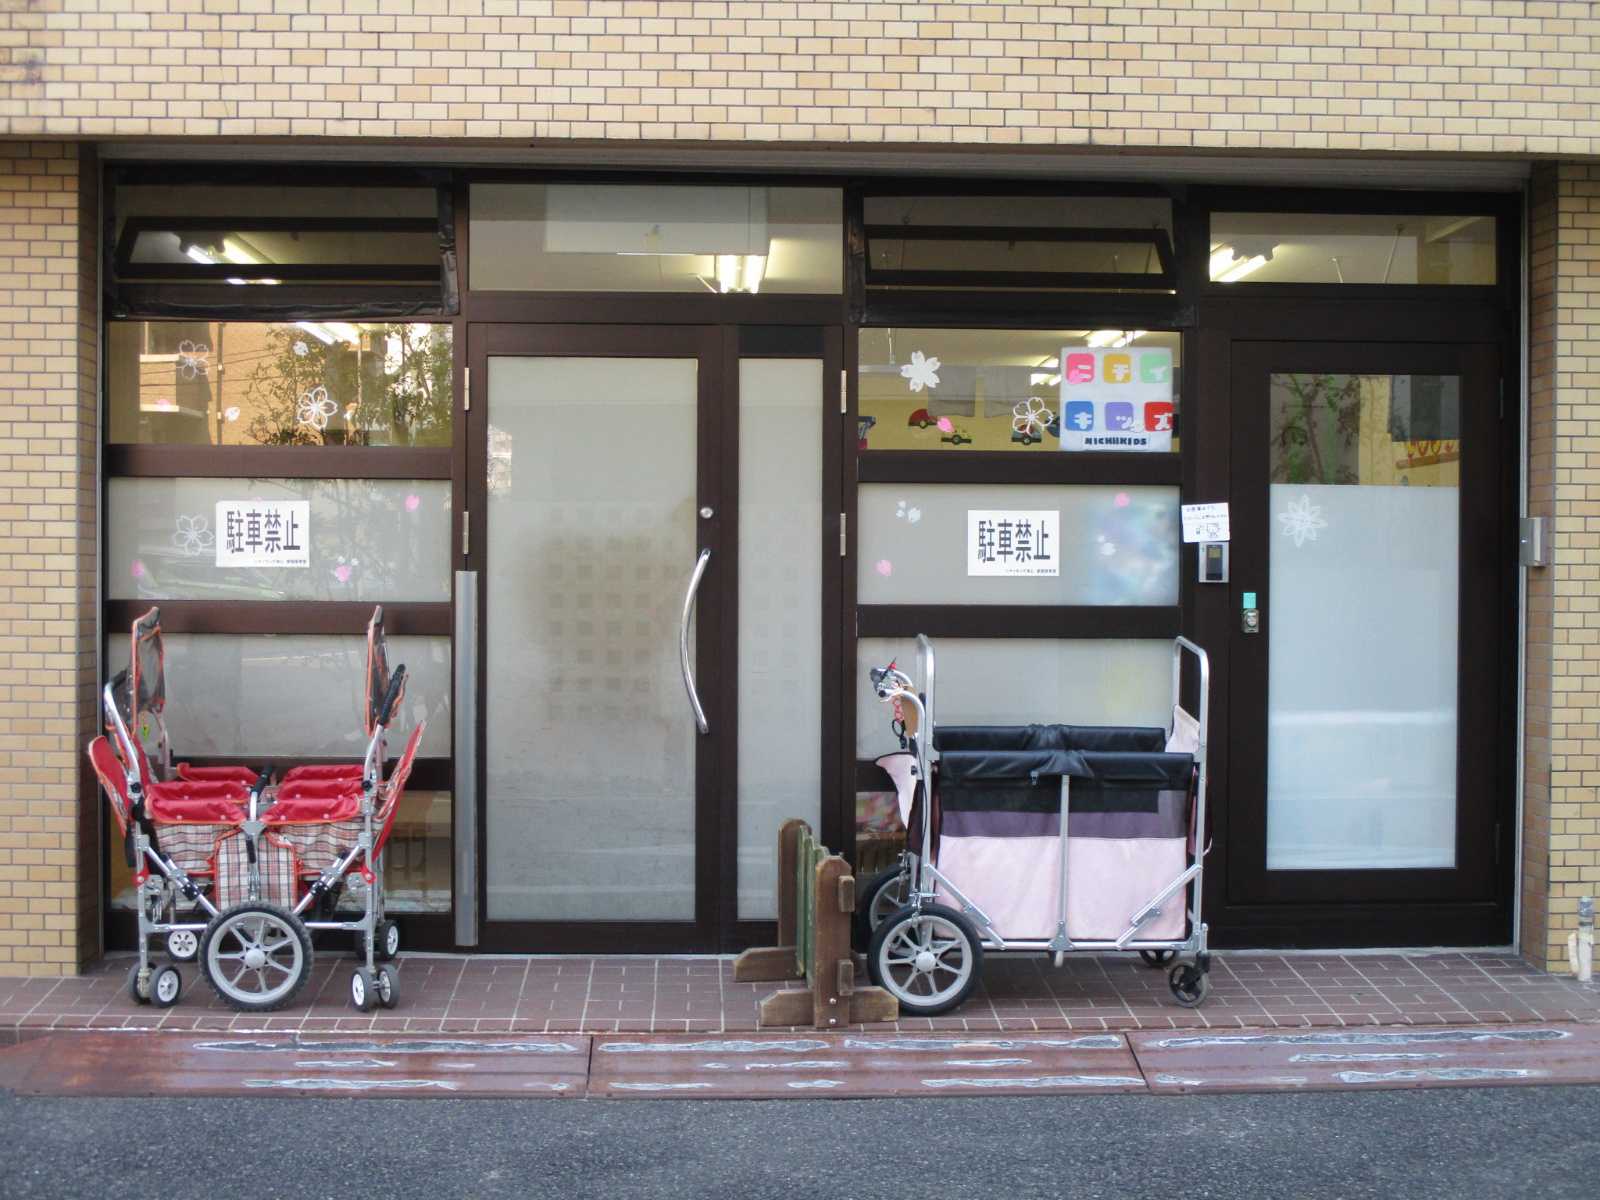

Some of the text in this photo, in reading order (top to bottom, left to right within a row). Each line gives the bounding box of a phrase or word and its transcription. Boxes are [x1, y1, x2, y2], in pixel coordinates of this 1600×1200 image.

[1073, 361, 1168, 382] ニチイ
[1072, 411, 1173, 431] キッズ
[1084, 436, 1147, 446] NICHIIKIDS
[226, 508, 301, 554] 駐車禁止
[977, 518, 1051, 563] 駐車禁止
